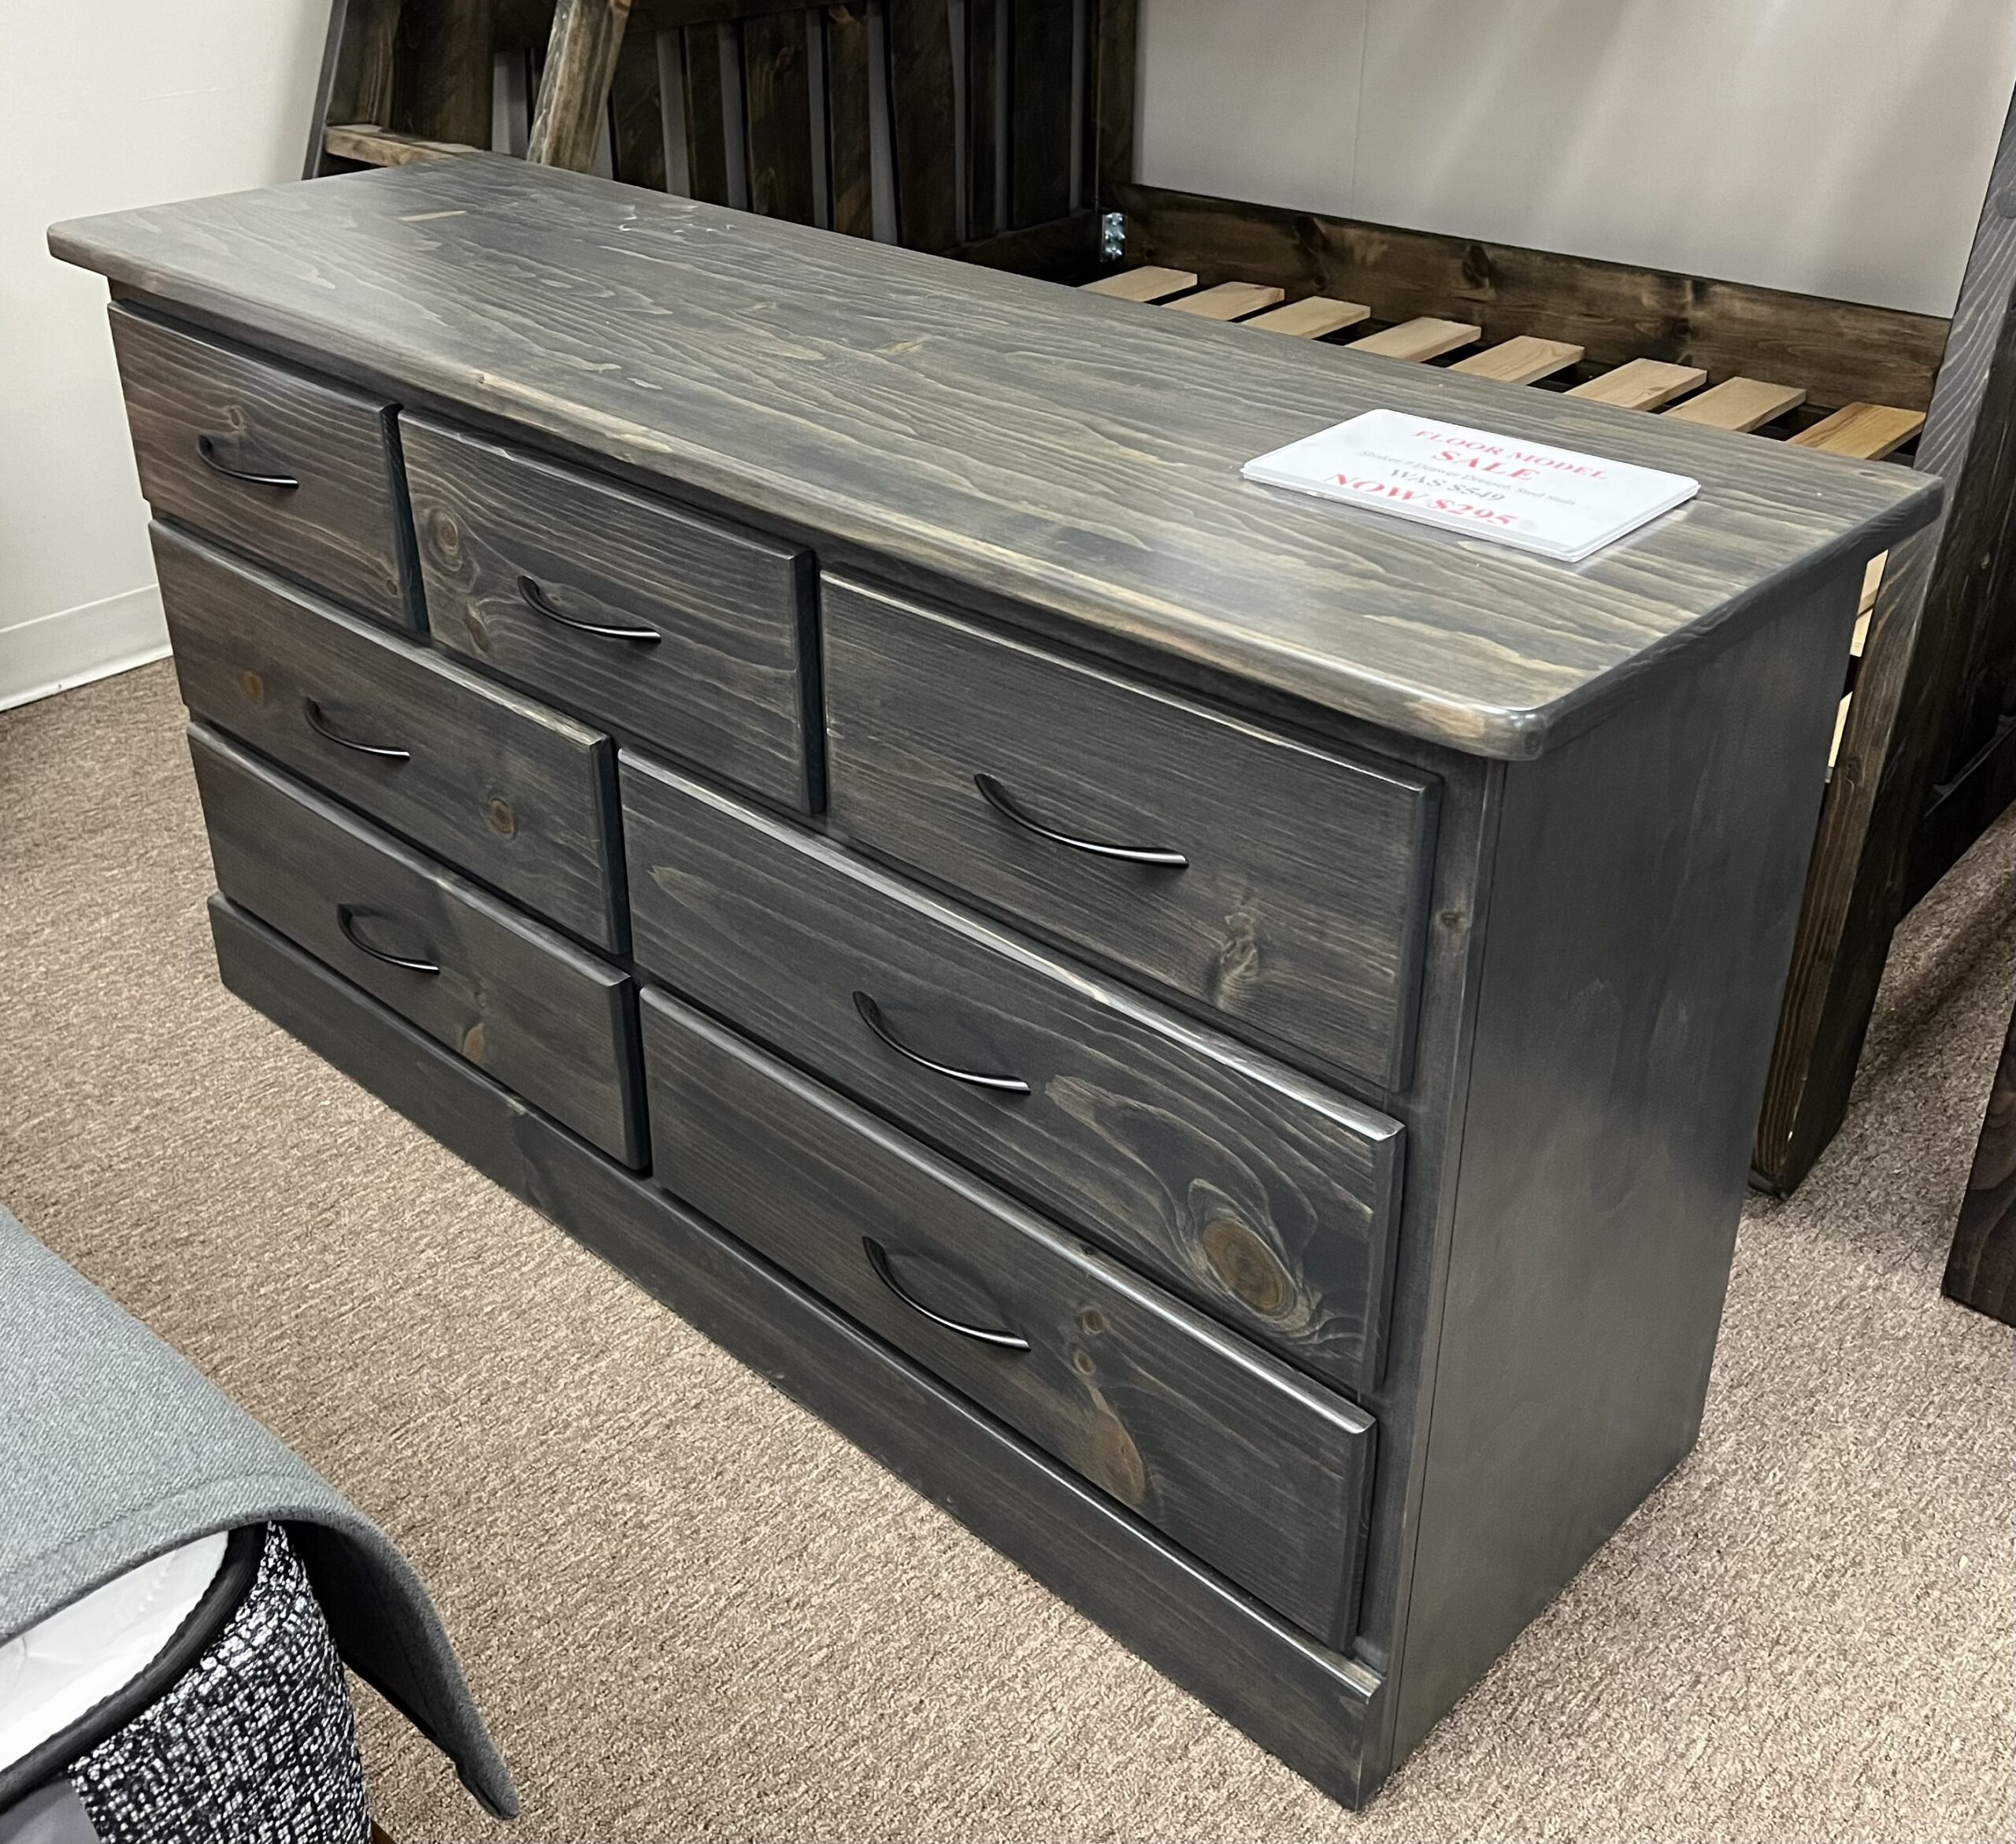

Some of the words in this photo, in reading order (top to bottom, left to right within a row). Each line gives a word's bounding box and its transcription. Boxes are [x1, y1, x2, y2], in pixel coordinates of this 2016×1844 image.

[1414, 431, 1504, 455] FLOOR
[1506, 451, 1607, 480] MODEL
[1431, 450, 1541, 480] SALE
[1322, 473, 1430, 501] NOW
[1426, 498, 1519, 525] $295
[1390, 468, 1447, 487] WAS
[1447, 483, 1506, 502] $549
